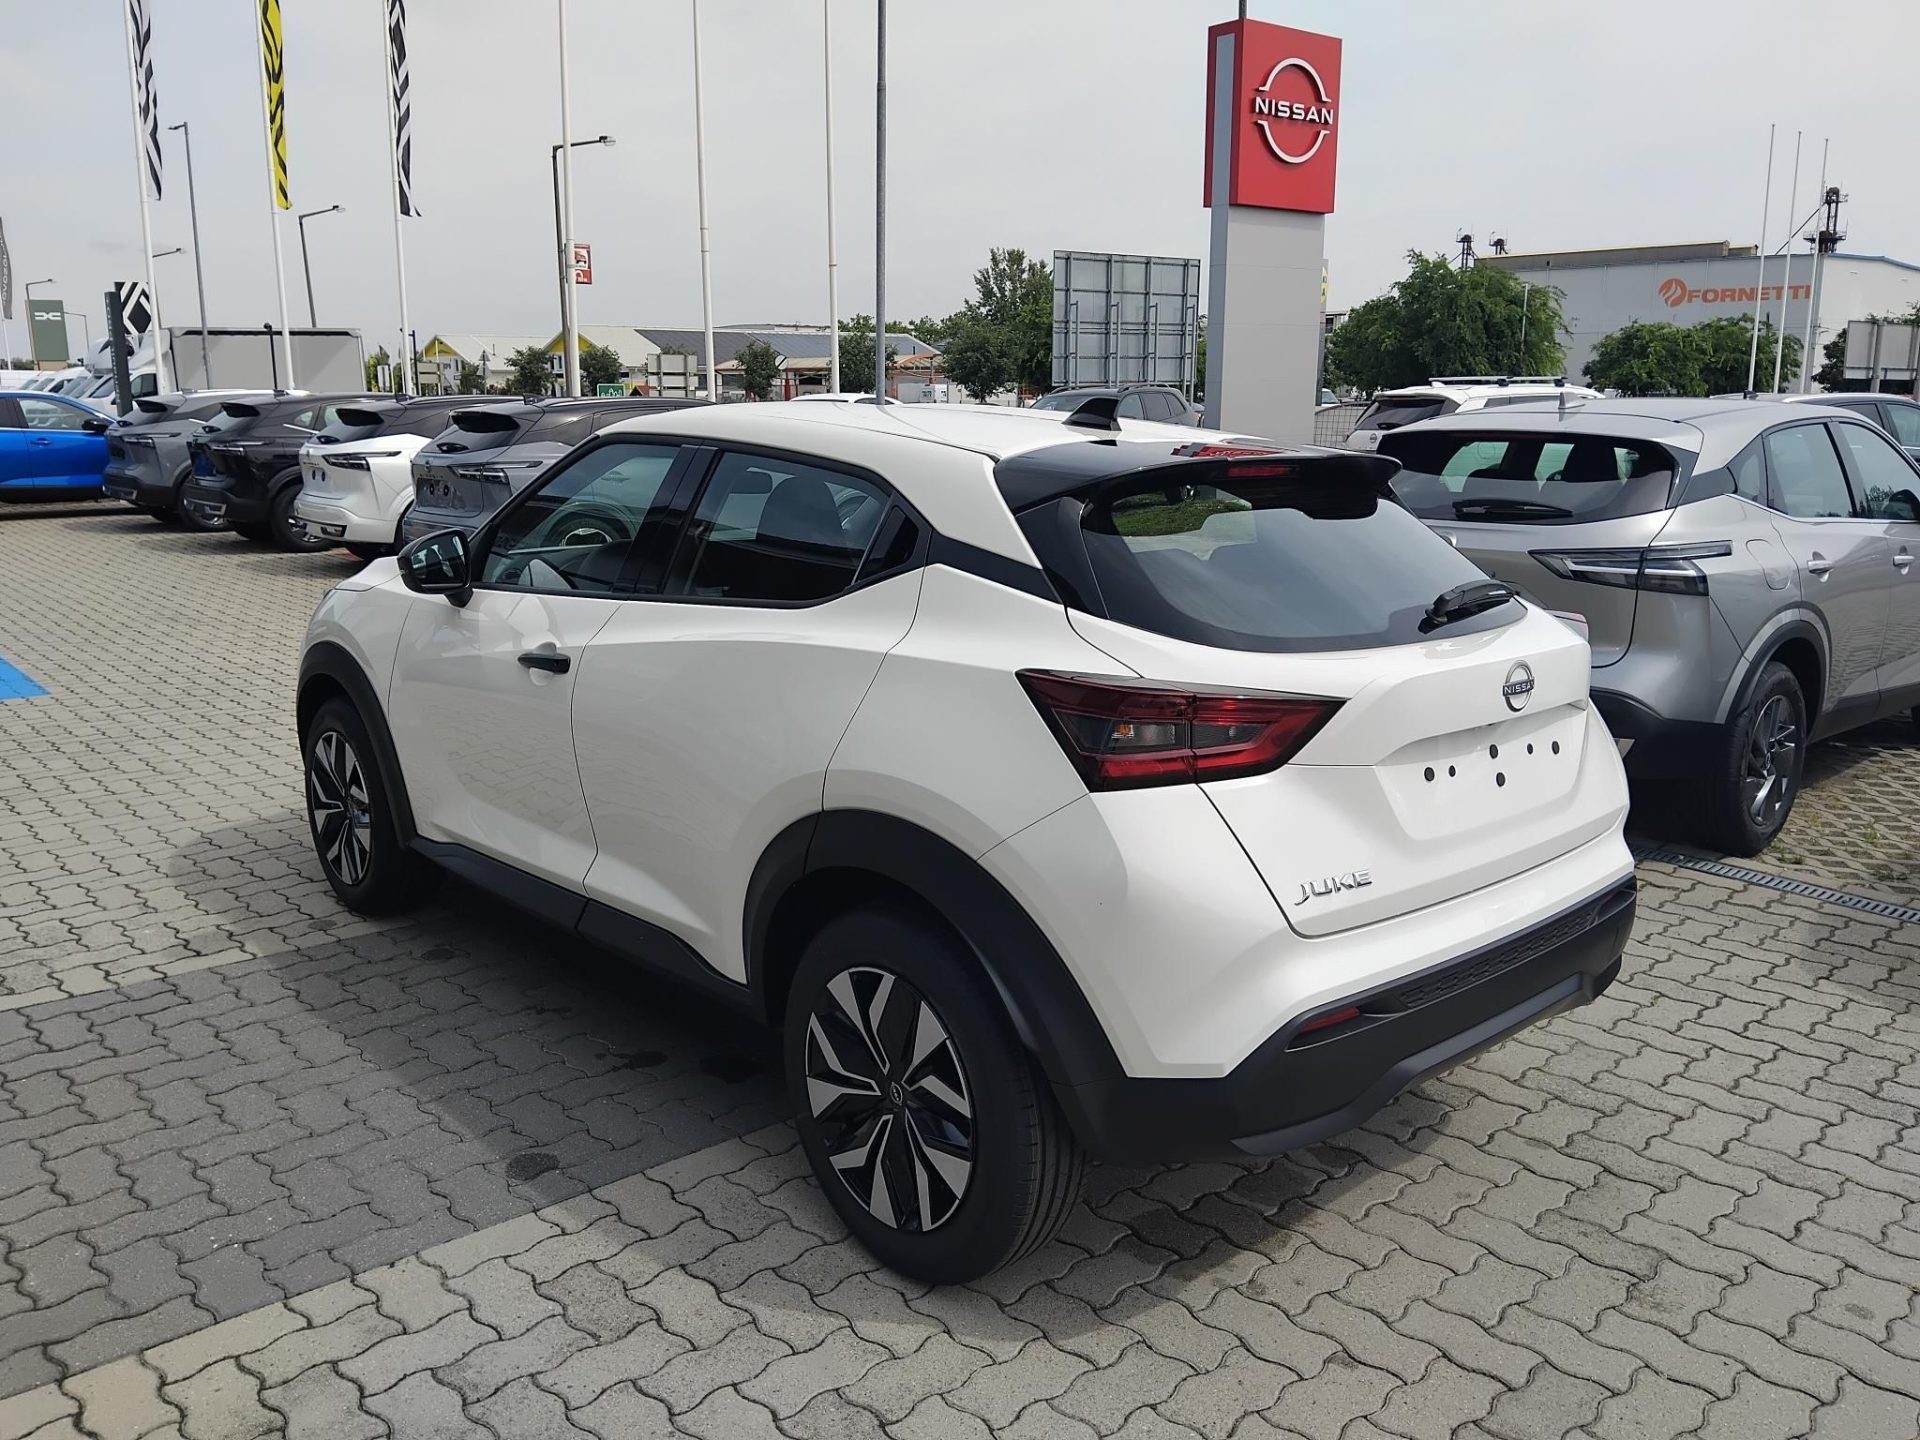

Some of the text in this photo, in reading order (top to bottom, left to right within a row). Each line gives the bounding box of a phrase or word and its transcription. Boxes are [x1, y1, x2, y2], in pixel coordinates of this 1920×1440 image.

[1255, 96, 1334, 125] NISSAN
[1686, 284, 1812, 304] FORNETTI
[1294, 868, 1372, 906] JUKE
